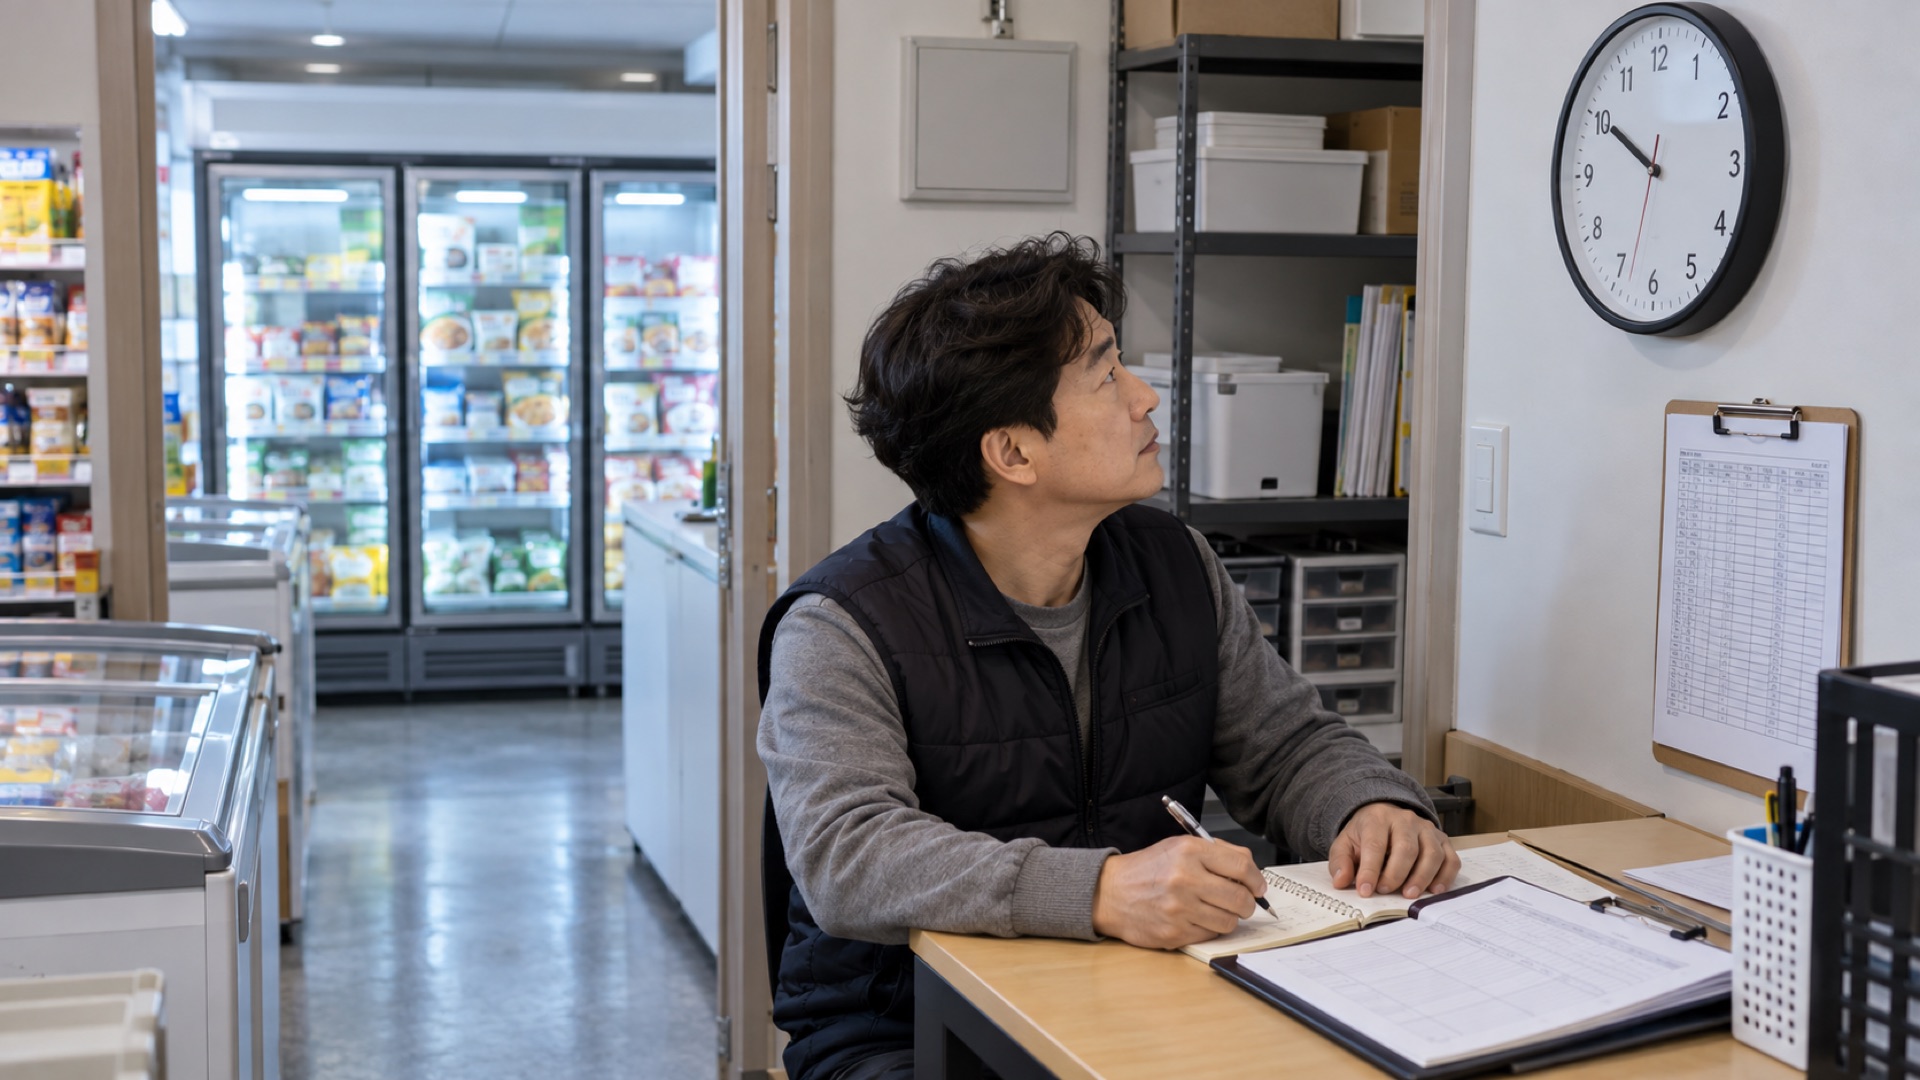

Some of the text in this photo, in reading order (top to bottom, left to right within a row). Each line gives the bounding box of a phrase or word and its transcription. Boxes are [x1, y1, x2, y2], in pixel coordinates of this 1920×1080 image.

[1651, 44, 1668, 72] 12
[1692, 54, 1699, 80] 1
[1620, 66, 1633, 92] 11
[1717, 92, 1729, 119] 2
[1595, 110, 1611, 135] 10
[1584, 164, 1593, 187] 9
[1729, 150, 1740, 177] 3
[1593, 216, 1602, 239] 8
[1714, 210, 1727, 236] 4
[1617, 253, 1626, 278] 7
[1686, 254, 1696, 280] 5
[1649, 269, 1658, 295] 6
